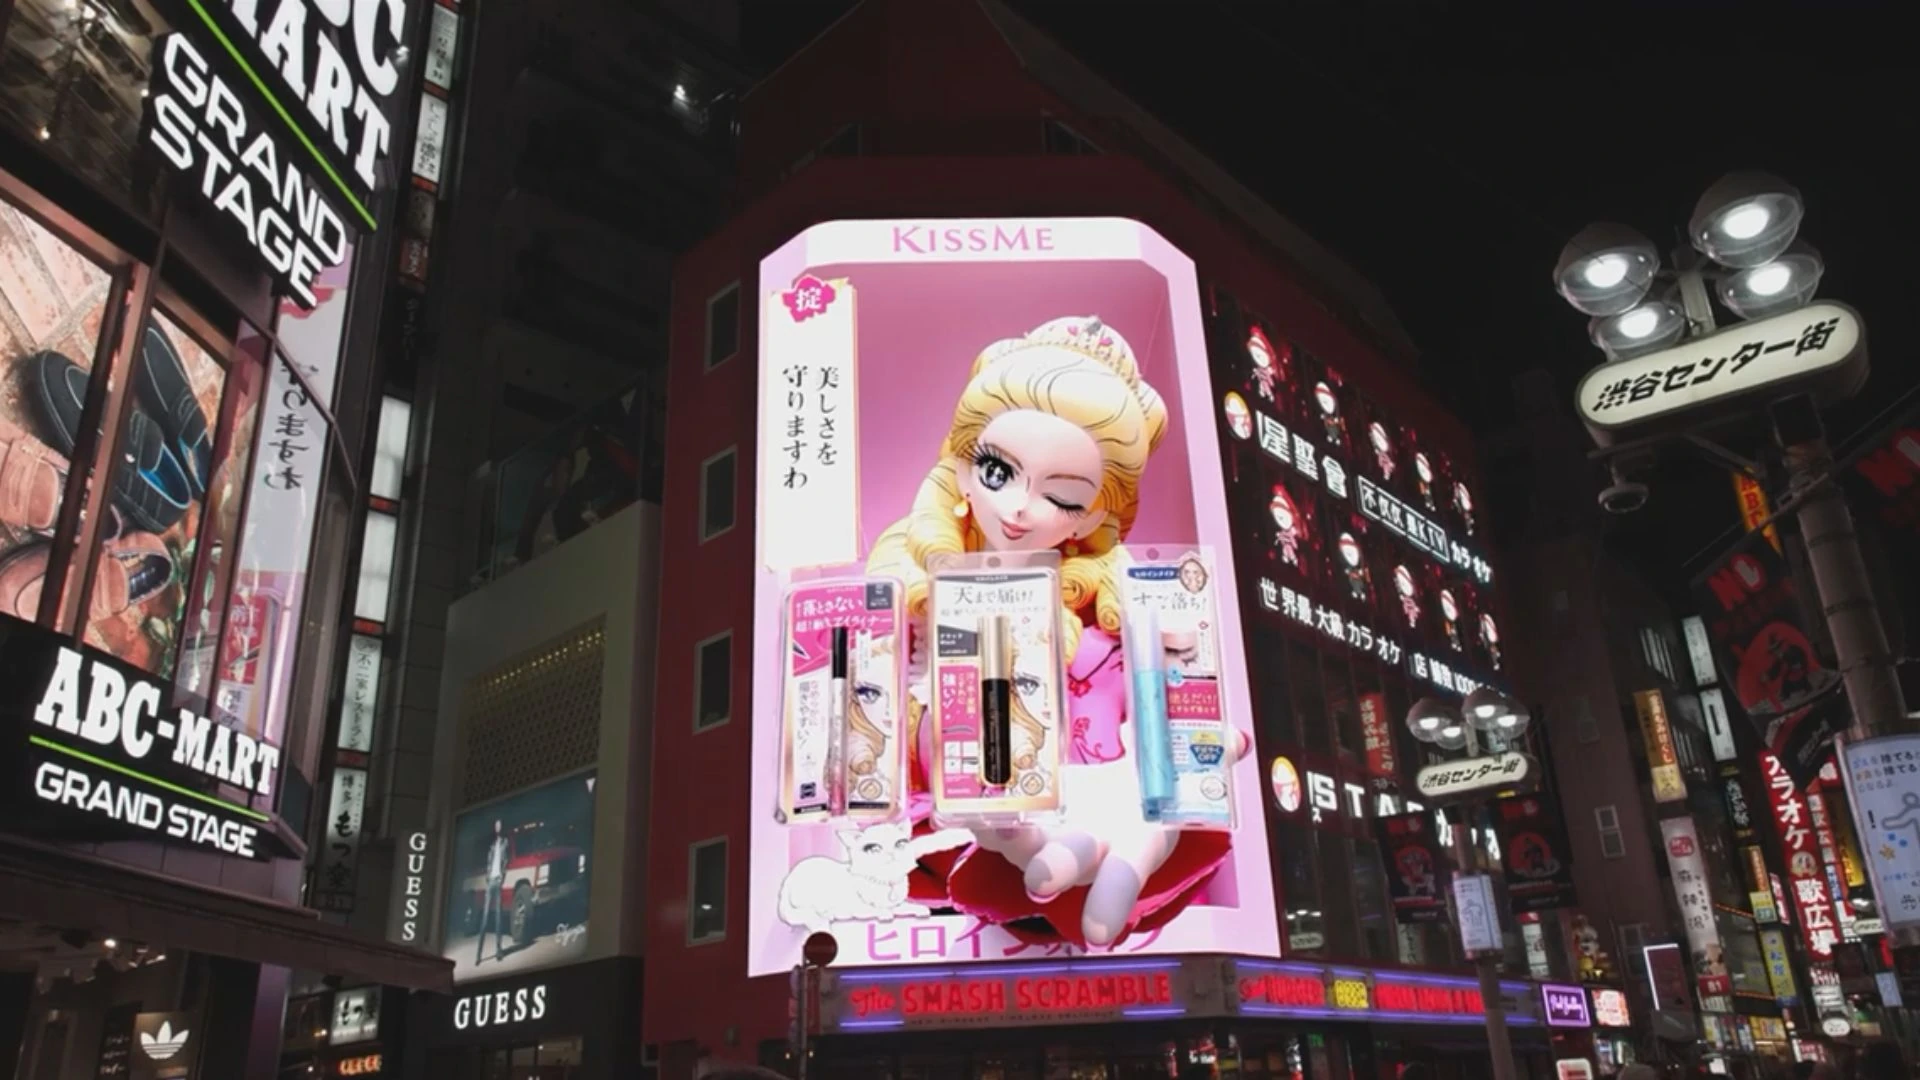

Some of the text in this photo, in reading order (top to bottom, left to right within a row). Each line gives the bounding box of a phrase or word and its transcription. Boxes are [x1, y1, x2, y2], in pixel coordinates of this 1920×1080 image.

[164, 32, 347, 266] GRAND
[150, 94, 323, 308] STAGE
[1592, 316, 1840, 412] 渋谷センター街
[783, 364, 809, 490] 守りますわ
[816, 366, 839, 466] 美しさを
[34, 646, 280, 795] ABC-MART
[34, 762, 258, 859] GRAND STAGE
[1422, 756, 1521, 789] 渋谷センター街
[402, 832, 427, 942] GUESS
[454, 985, 547, 1030] GUESS
[903, 981, 1007, 1014] SMASH
[1016, 974, 1174, 1009] SCRAMBLE
